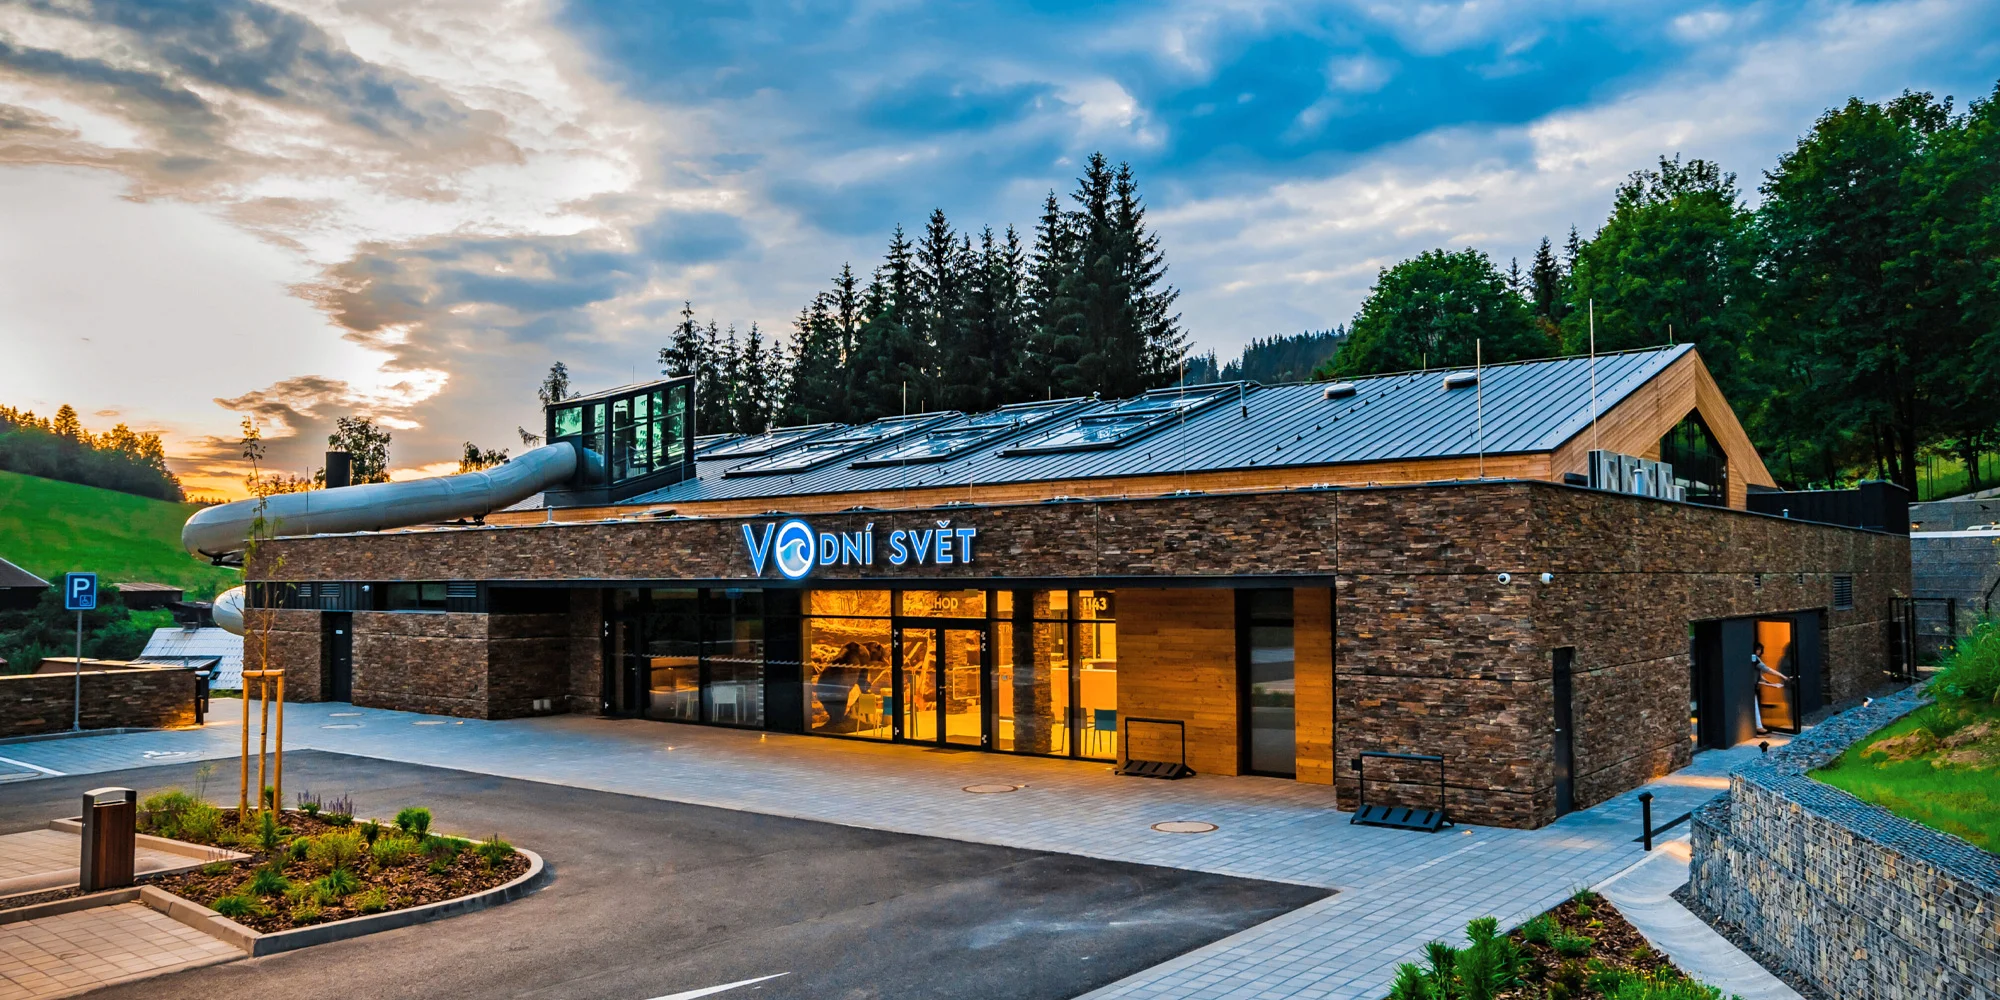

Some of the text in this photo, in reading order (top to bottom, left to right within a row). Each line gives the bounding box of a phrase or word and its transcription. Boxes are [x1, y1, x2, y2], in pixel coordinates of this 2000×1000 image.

[742, 519, 976, 579] VODNÍ SVĚT
[73, 578, 90, 598] P
[1082, 597, 1107, 610] 1143
